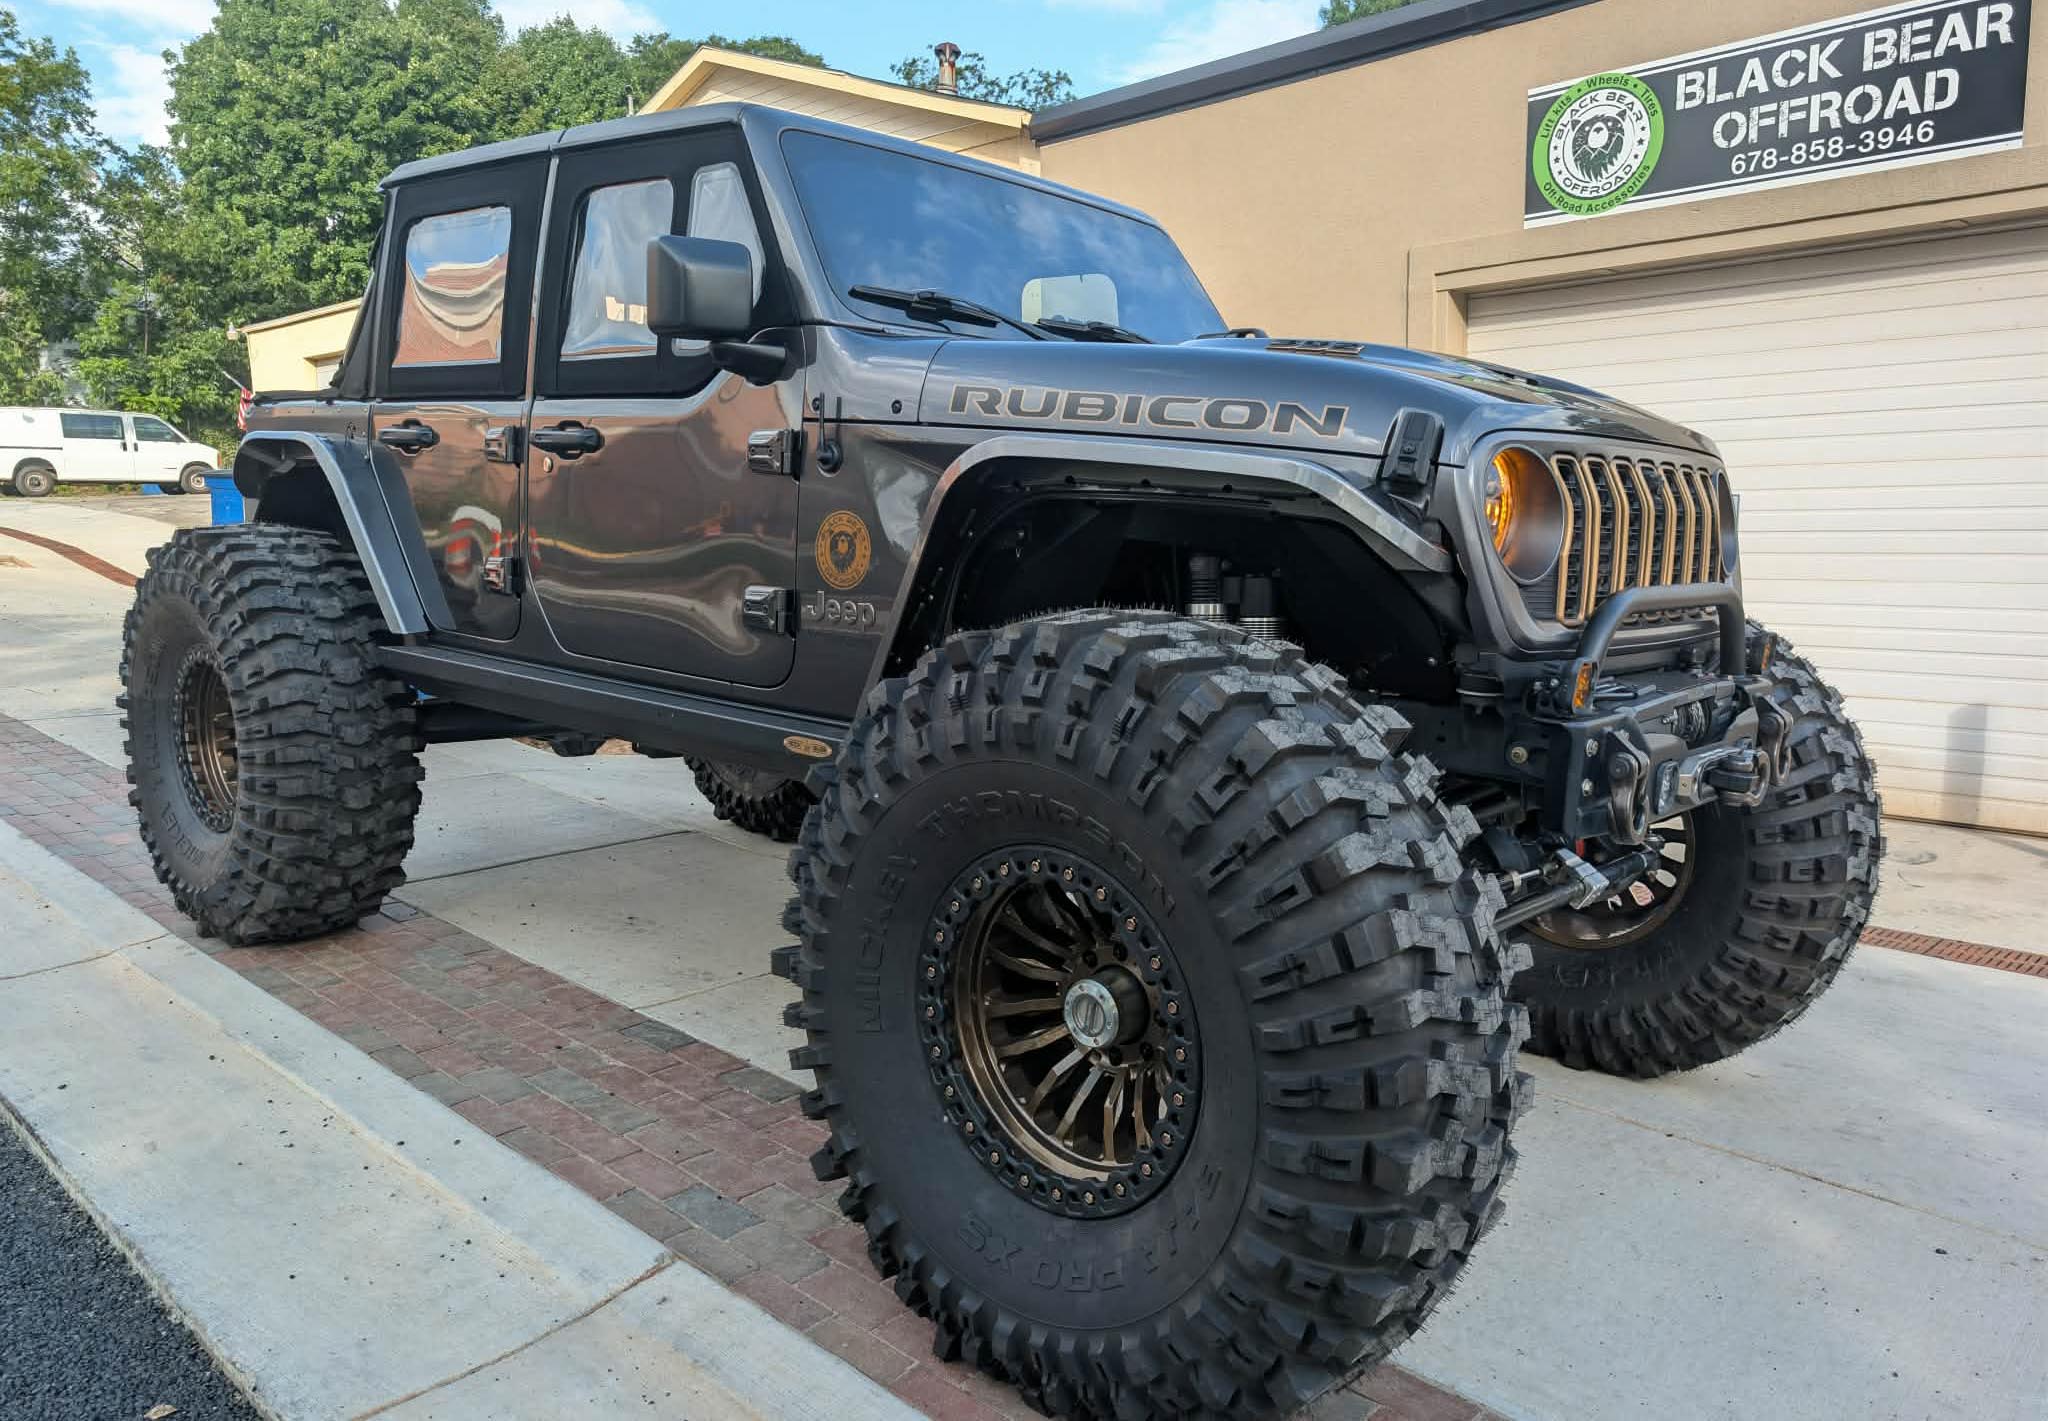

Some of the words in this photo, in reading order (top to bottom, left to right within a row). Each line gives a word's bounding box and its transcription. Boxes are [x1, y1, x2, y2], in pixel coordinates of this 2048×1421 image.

[1675, 39, 1845, 111] BLACK
[1863, 3, 2014, 72] BEAR
[1555, 93, 1600, 139] BLACK
[1606, 91, 1643, 122] BEAR
[1586, 75, 1630, 88] Wheels
[1639, 88, 1659, 117] Tires
[1712, 67, 1961, 149] OFFROAD
[1730, 120, 1935, 175] 678-858-3946
[1562, 164, 1633, 195] OFFROAD
[1586, 164, 1650, 213] Accessories
[948, 384, 1351, 439] RUBICON
[807, 590, 877, 632] Jeep
[855, 854, 919, 1034] MICKEY
[916, 790, 1176, 918] THOMPSON
[959, 1212, 1023, 1273] XS
[1030, 1254, 1126, 1293] PRO
